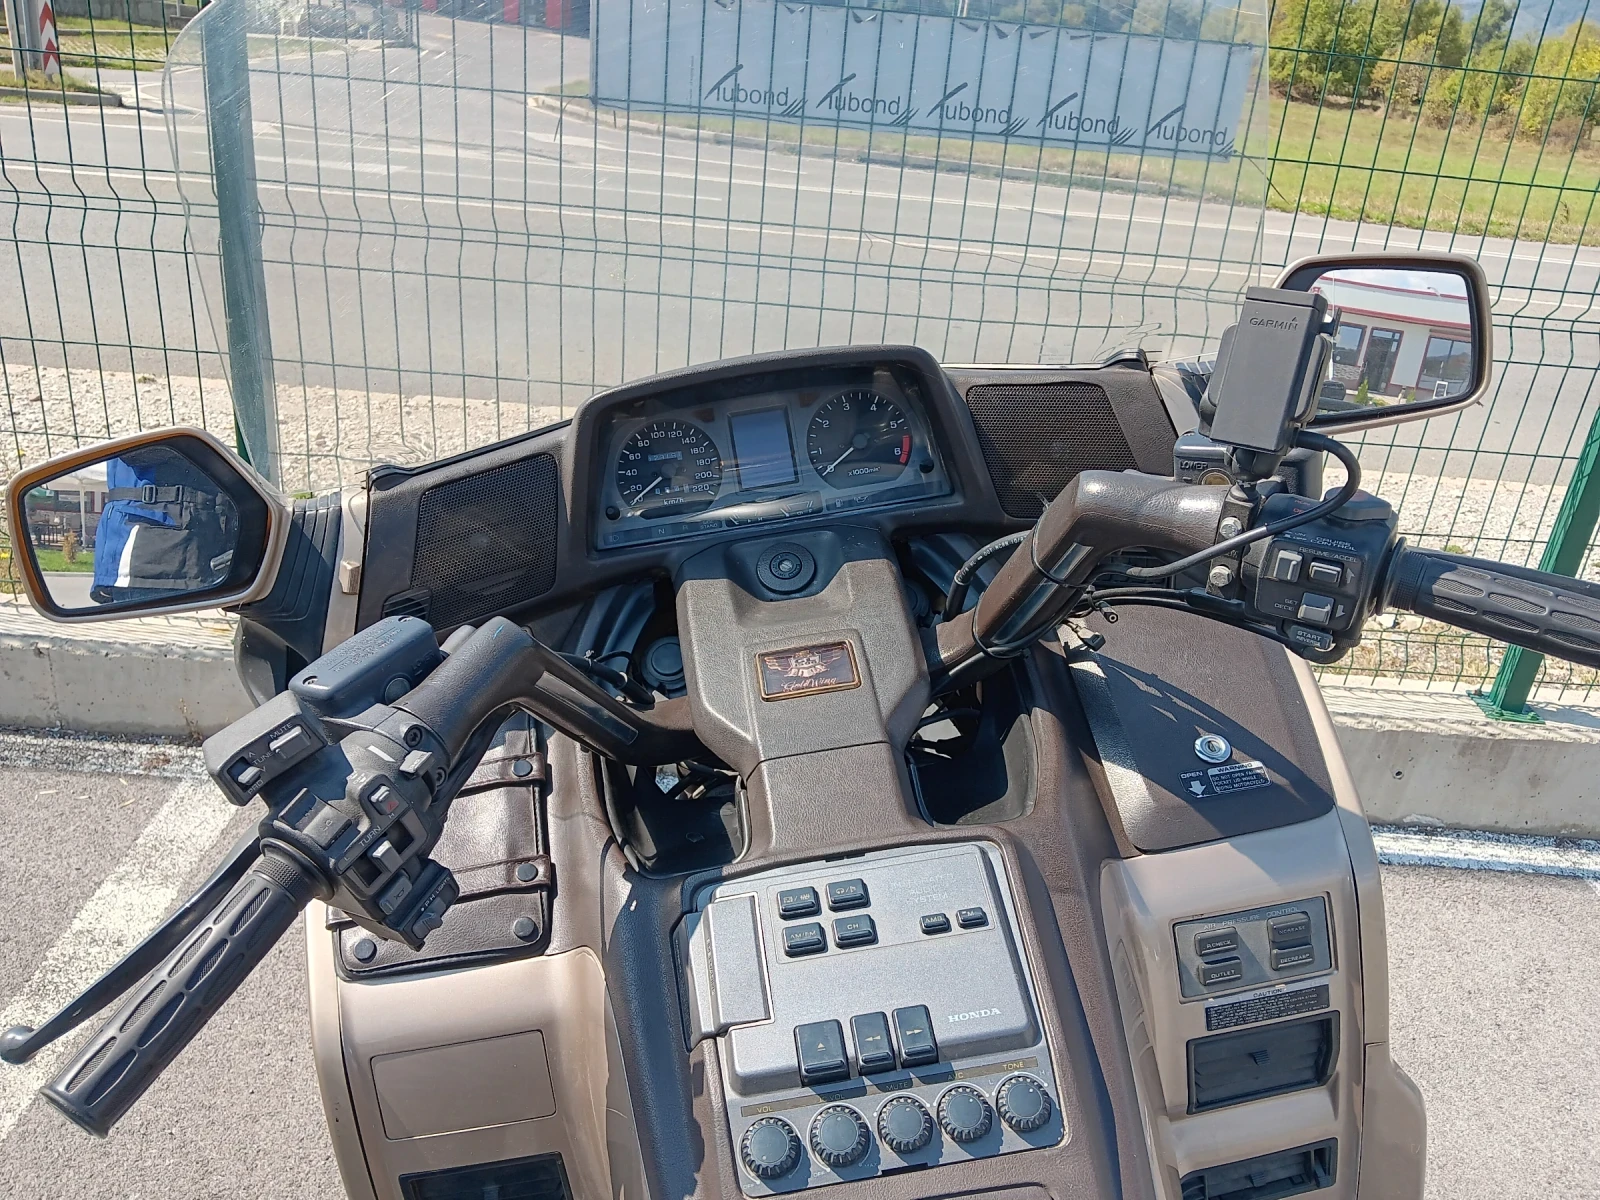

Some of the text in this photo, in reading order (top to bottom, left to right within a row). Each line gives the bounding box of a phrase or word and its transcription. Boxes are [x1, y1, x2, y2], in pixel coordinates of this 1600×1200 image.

[1249, 317, 1298, 331] GARMIN
[843, 403, 850, 411] 3
[822, 420, 829, 428] 2
[890, 421, 897, 429] 5
[650, 431, 665, 439] 100
[668, 430, 683, 438] 120
[681, 437, 696, 445] 140
[1180, 460, 1208, 470] LOWER
[694, 471, 712, 479] 200
[630, 484, 642, 492] 20
[692, 484, 710, 492] 220
[1310, 539, 1357, 551] CONTROL
[1297, 630, 1322, 641] START
[269, 722, 293, 740] MUTE
[253, 751, 273, 766] TUNE
[1216, 762, 1253, 773] WARNING
[1180, 771, 1203, 779] OPEN
[358, 825, 382, 847] TURN
[1222, 914, 1260, 926] PRESSURE
[1266, 906, 1300, 918] CONTROL
[1211, 969, 1235, 979] OUTLET
[1252, 988, 1283, 998] CAUTION
[947, 1007, 1002, 1023] HONDA
[1002, 1061, 1025, 1071] TONE
[886, 1081, 909, 1091] MUTE
[829, 1093, 846, 1101] VOL
[756, 1105, 774, 1113] VOL
